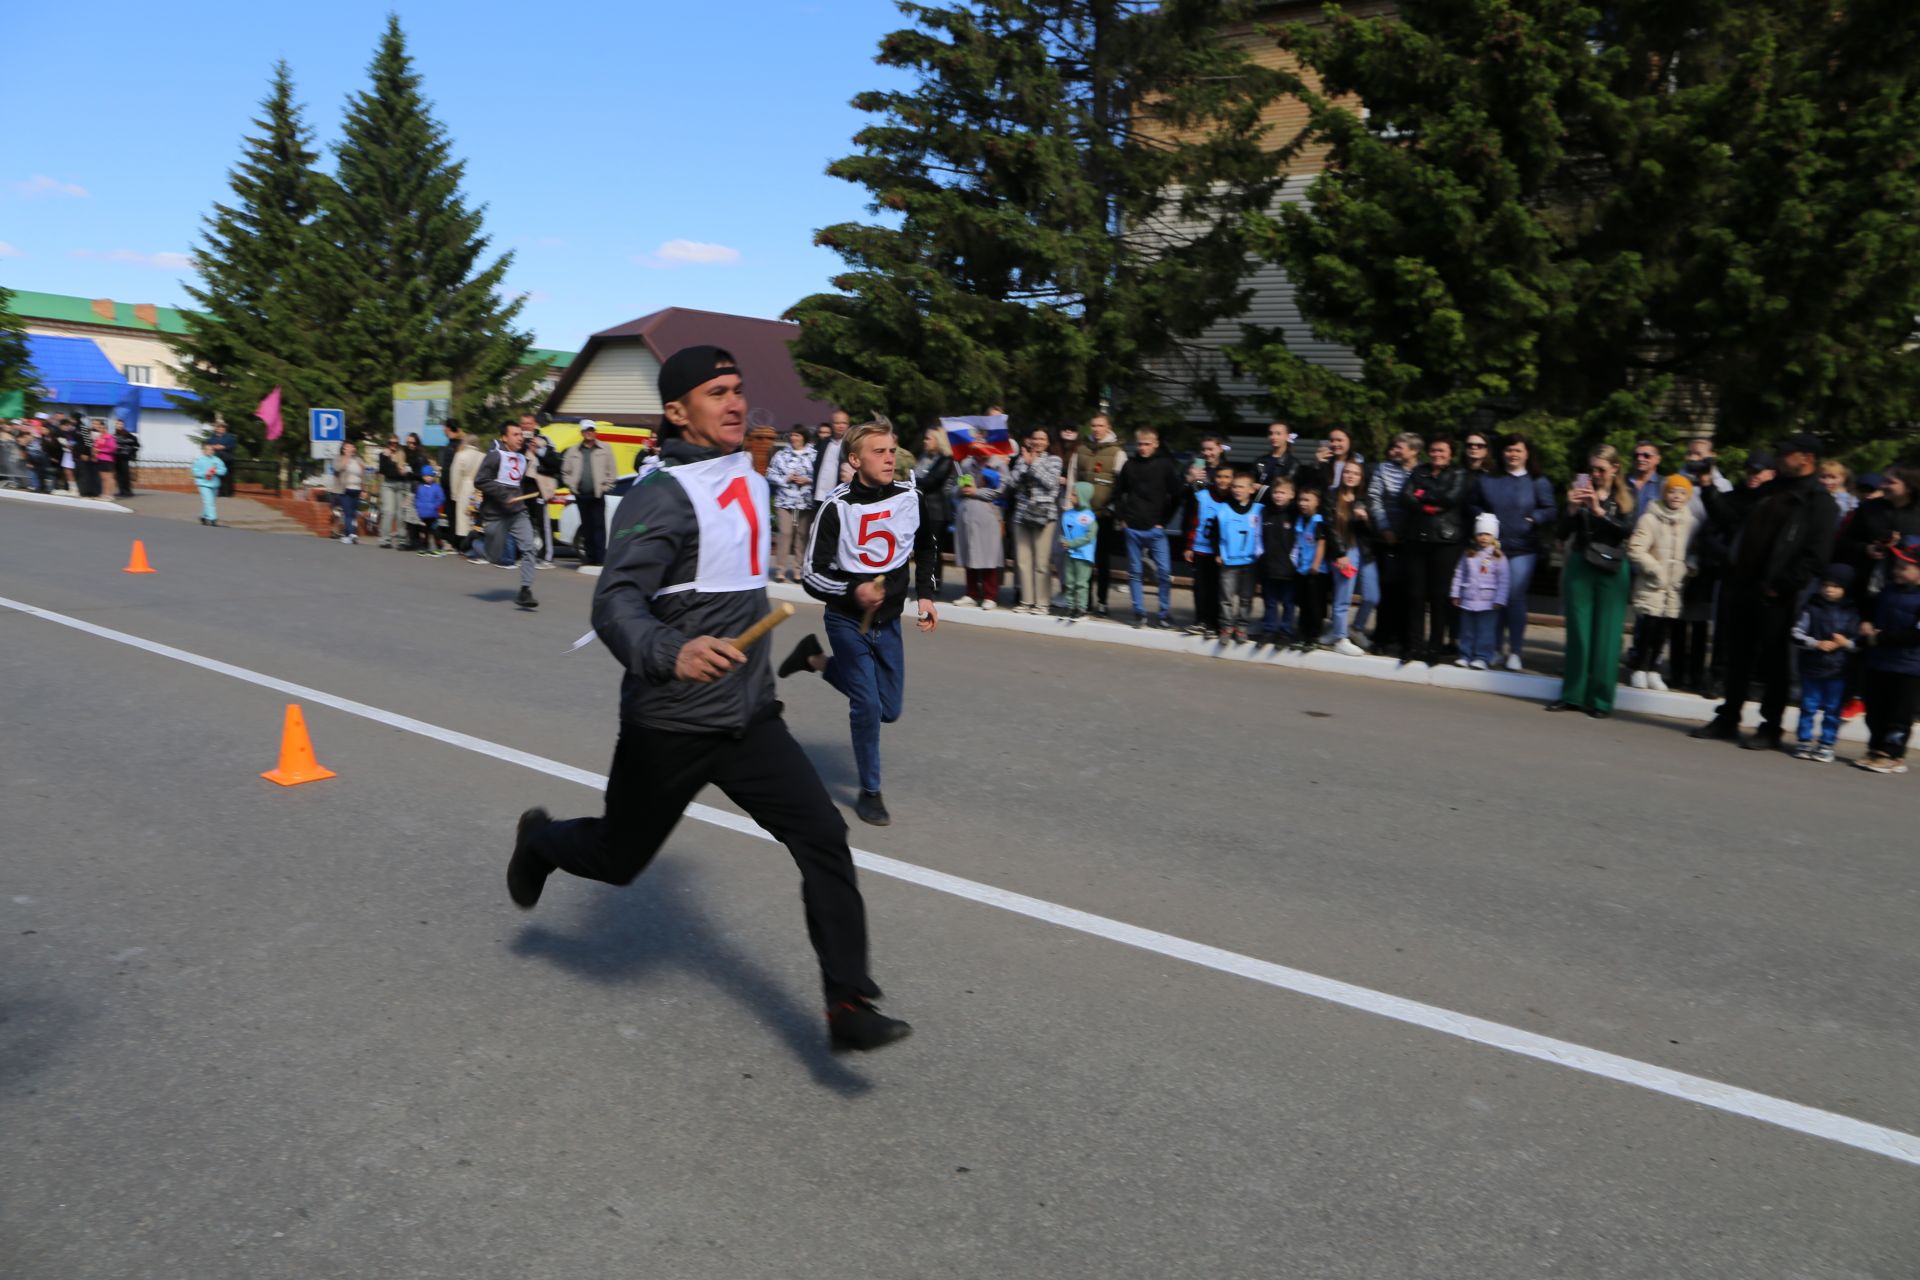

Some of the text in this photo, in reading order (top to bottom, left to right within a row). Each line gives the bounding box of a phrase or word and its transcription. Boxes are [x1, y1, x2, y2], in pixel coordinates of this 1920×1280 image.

[320, 413, 339, 438] P
[508, 456, 522, 481] 3
[717, 475, 762, 576] 1
[858, 510, 896, 568] 5
[1238, 529, 1249, 552] 7
